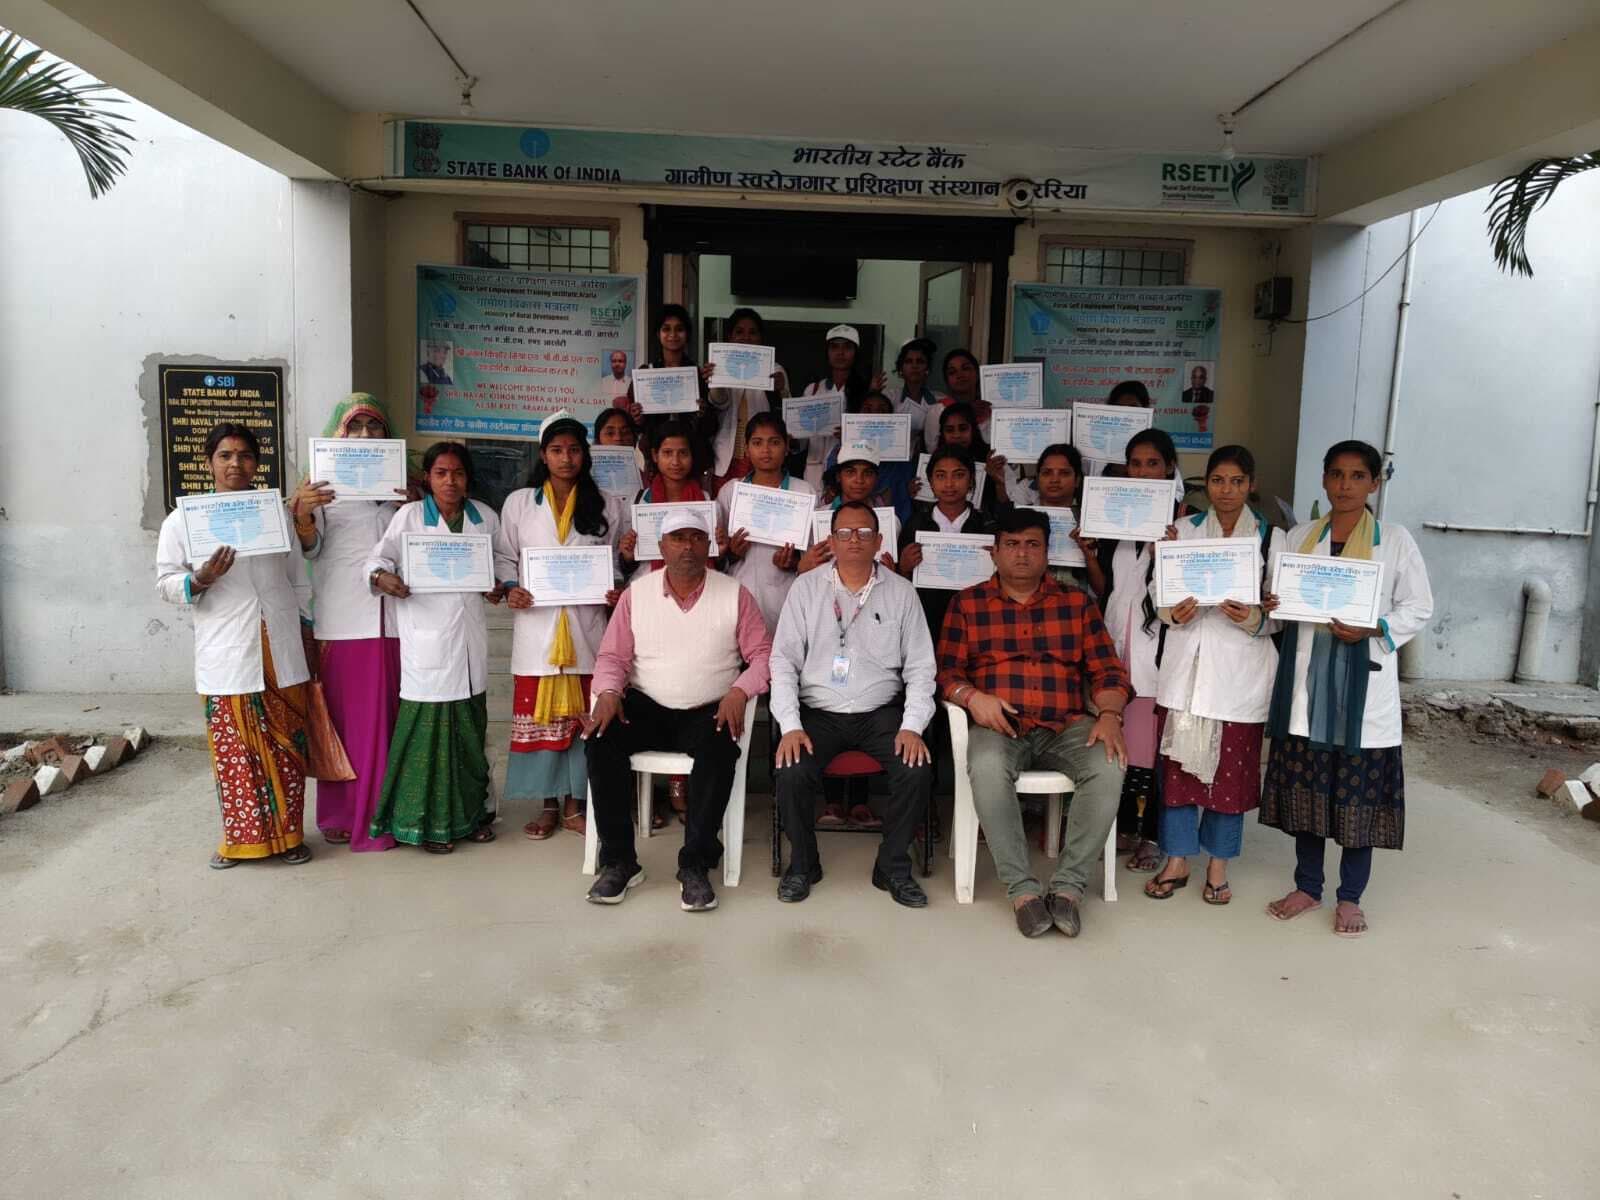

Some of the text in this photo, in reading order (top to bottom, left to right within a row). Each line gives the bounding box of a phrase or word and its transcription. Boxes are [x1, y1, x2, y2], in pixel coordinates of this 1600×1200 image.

[793, 144, 966, 169] भारतीय स्टेट बैंक
[447, 160, 497, 178] STATE
[502, 163, 547, 179] BANK
[577, 168, 622, 183] INDIA
[1161, 163, 1229, 183] RSETI
[737, 169, 840, 192] स्वरोजगार
[845, 172, 922, 195] प्रशिक्षण
[928, 176, 1001, 197] संस्थान
[1031, 178, 1088, 200] ररिया
[591, 307, 620, 319] RSETI
[1176, 319, 1206, 330] RSETI
[217, 376, 235, 387] SBI
[183, 388, 260, 398] STATE BANK OF INDIA
[490, 383, 523, 393] WELCOME
[559, 387, 576, 395] YOU
[172, 417, 189, 426] SHRI
[190, 418, 213, 427] NAVAL
[245, 419, 273, 428] MISHRA
[175, 434, 182, 442] In
[173, 444, 191, 453] SHRI
[259, 446, 274, 455] DAS
[178, 462, 198, 472] SHRI
[180, 482, 201, 490] SHRI
